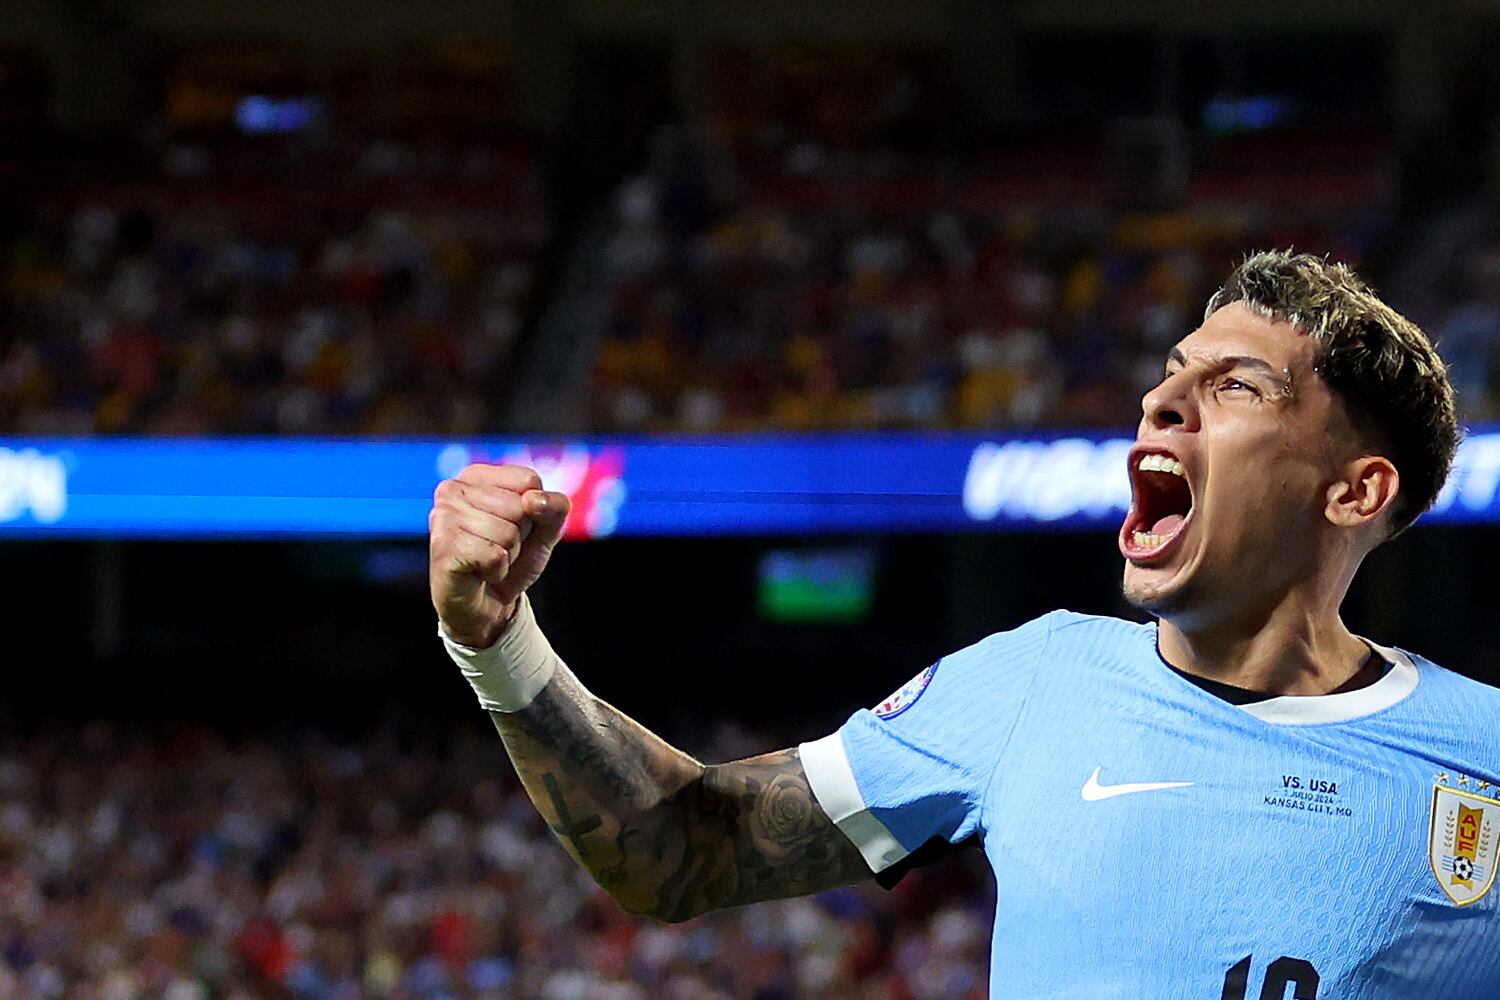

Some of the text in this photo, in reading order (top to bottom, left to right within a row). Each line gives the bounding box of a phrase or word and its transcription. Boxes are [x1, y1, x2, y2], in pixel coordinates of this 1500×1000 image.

[1282, 775, 1337, 795] VS. USA
[1290, 790, 1313, 801] JULIO
[1264, 795, 1305, 810] KANSAS
[1336, 807, 1352, 817] MO
[1458, 814, 1477, 852] AUF
